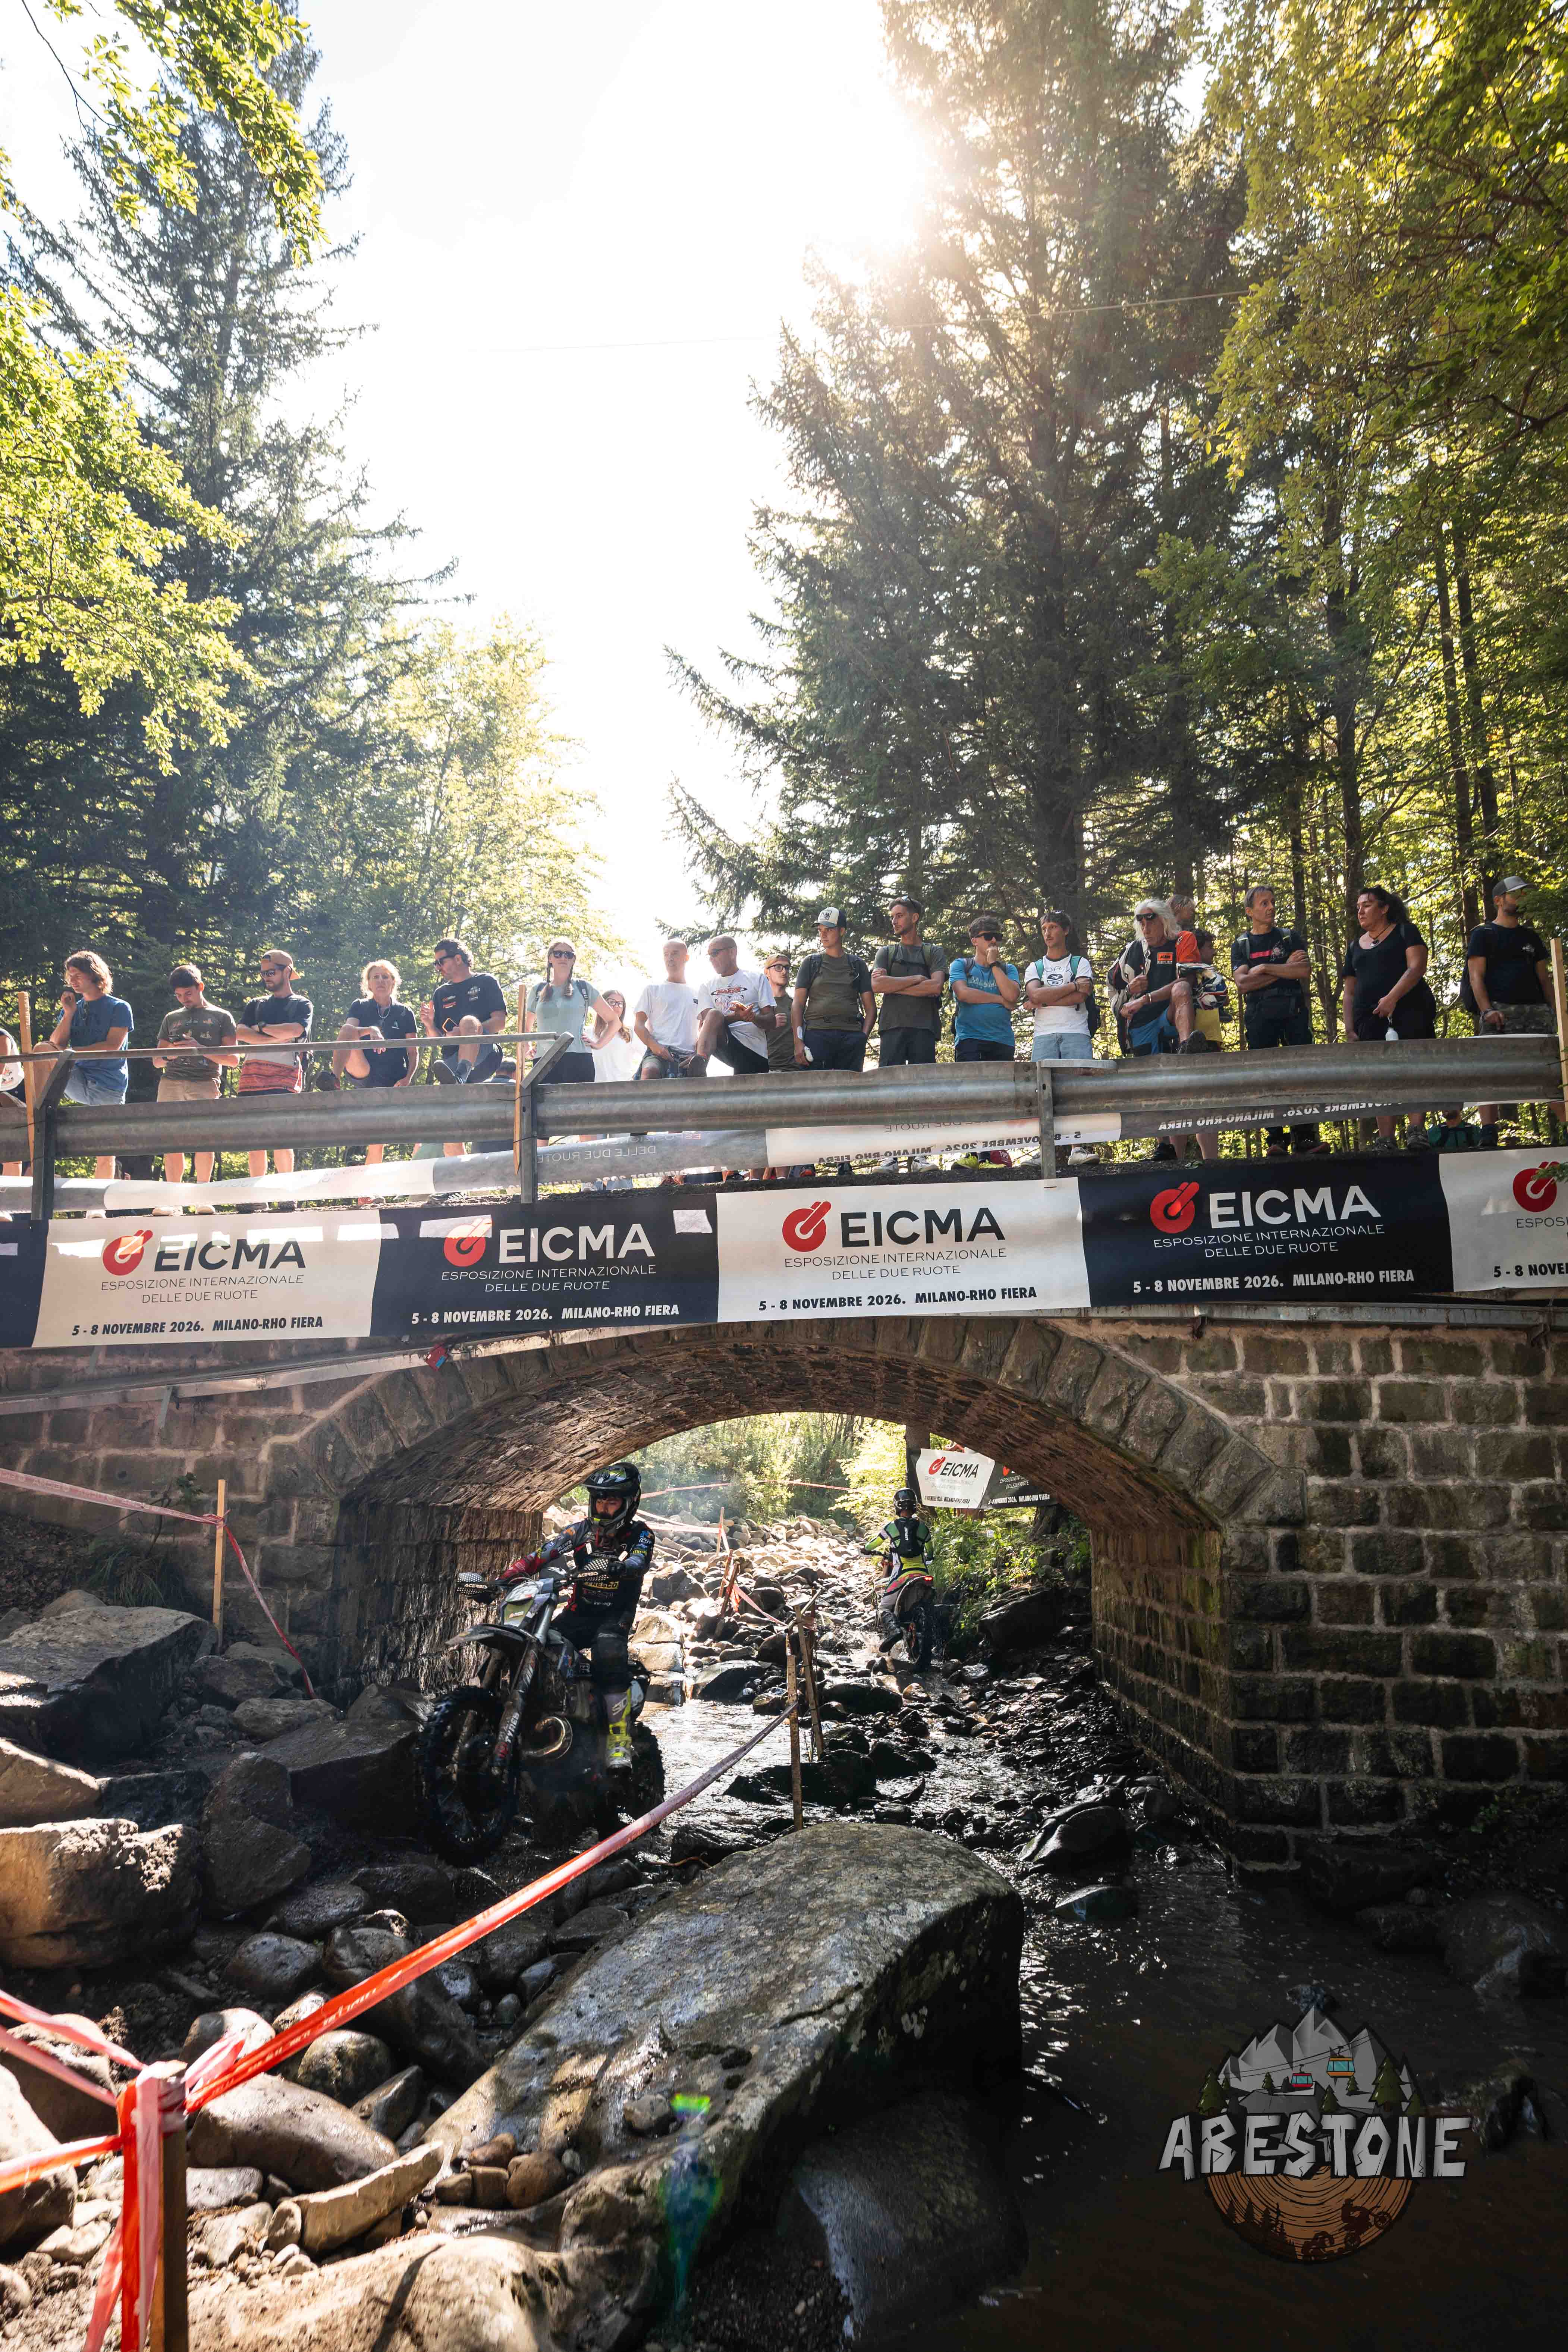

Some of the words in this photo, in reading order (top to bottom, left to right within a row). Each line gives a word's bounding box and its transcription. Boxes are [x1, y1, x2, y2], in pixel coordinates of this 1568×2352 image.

[1209, 1185, 1381, 1228] EICMA
[841, 1207, 1005, 1248] EICMA
[1154, 1233, 1253, 1247] ESPOSIZIONE
[1256, 1225, 1385, 1242] INTERNAZIONALE
[499, 1224, 655, 1263] EICMA
[1205, 1247, 1251, 1257] DELLE
[1254, 1244, 1285, 1254] DUE
[1289, 1242, 1338, 1253] RUOTE
[154, 1238, 306, 1272] EICMA
[785, 1254, 880, 1268] ESPOSIZIONE
[884, 1247, 1007, 1263] INTERNAZIONALE
[442, 1270, 533, 1280] ESPOSIZIONE
[537, 1265, 656, 1278] INTERNAZIONALE
[832, 1269, 876, 1280] DELLE
[880, 1268, 909, 1277] DUE
[913, 1265, 961, 1276] RUOTE
[1494, 1266, 1501, 1277] 5
[1515, 1265, 1523, 1277] 8
[1528, 1263, 1568, 1276] NOVE
[101, 1278, 186, 1290] ESPOSIZIONE
[190, 1275, 304, 1287] INTERNAZIONALE
[485, 1282, 528, 1292] DELLE
[532, 1282, 559, 1291] DUE
[564, 1281, 610, 1290] RUOTE
[1134, 1281, 1141, 1293] 5
[1154, 1280, 1163, 1292] 8
[1168, 1277, 1239, 1291] NOVEMBRE
[1244, 1275, 1283, 1288] 2026.
[1293, 1271, 1374, 1286] MILANO-RHO
[1379, 1269, 1414, 1282] FIERA
[142, 1293, 182, 1303] DELLE
[185, 1292, 211, 1301] DUE
[215, 1290, 258, 1300] RUOTE
[759, 1301, 766, 1310] 5
[780, 1300, 787, 1310] 8
[793, 1296, 862, 1309] NOVEMBRE
[867, 1294, 906, 1306] 2026.
[915, 1289, 996, 1303] MILANO-RHO
[1001, 1287, 1037, 1299] FIERA
[412, 1313, 419, 1324] 5
[431, 1312, 439, 1323] 8
[444, 1310, 511, 1323] NOVEMBRE
[515, 1309, 552, 1321] 2026.
[562, 1306, 640, 1319] MILANO-RHO
[645, 1304, 679, 1316] FIERA
[72, 1325, 80, 1336] 5
[91, 1325, 98, 1335] 8
[101, 1322, 166, 1335] NOVEMBRE
[169, 1321, 204, 1332] 2026.
[212, 1318, 286, 1331] MILANO-RHO
[291, 1316, 323, 1328] FIERA
[940, 1462, 979, 1478] EICMA
